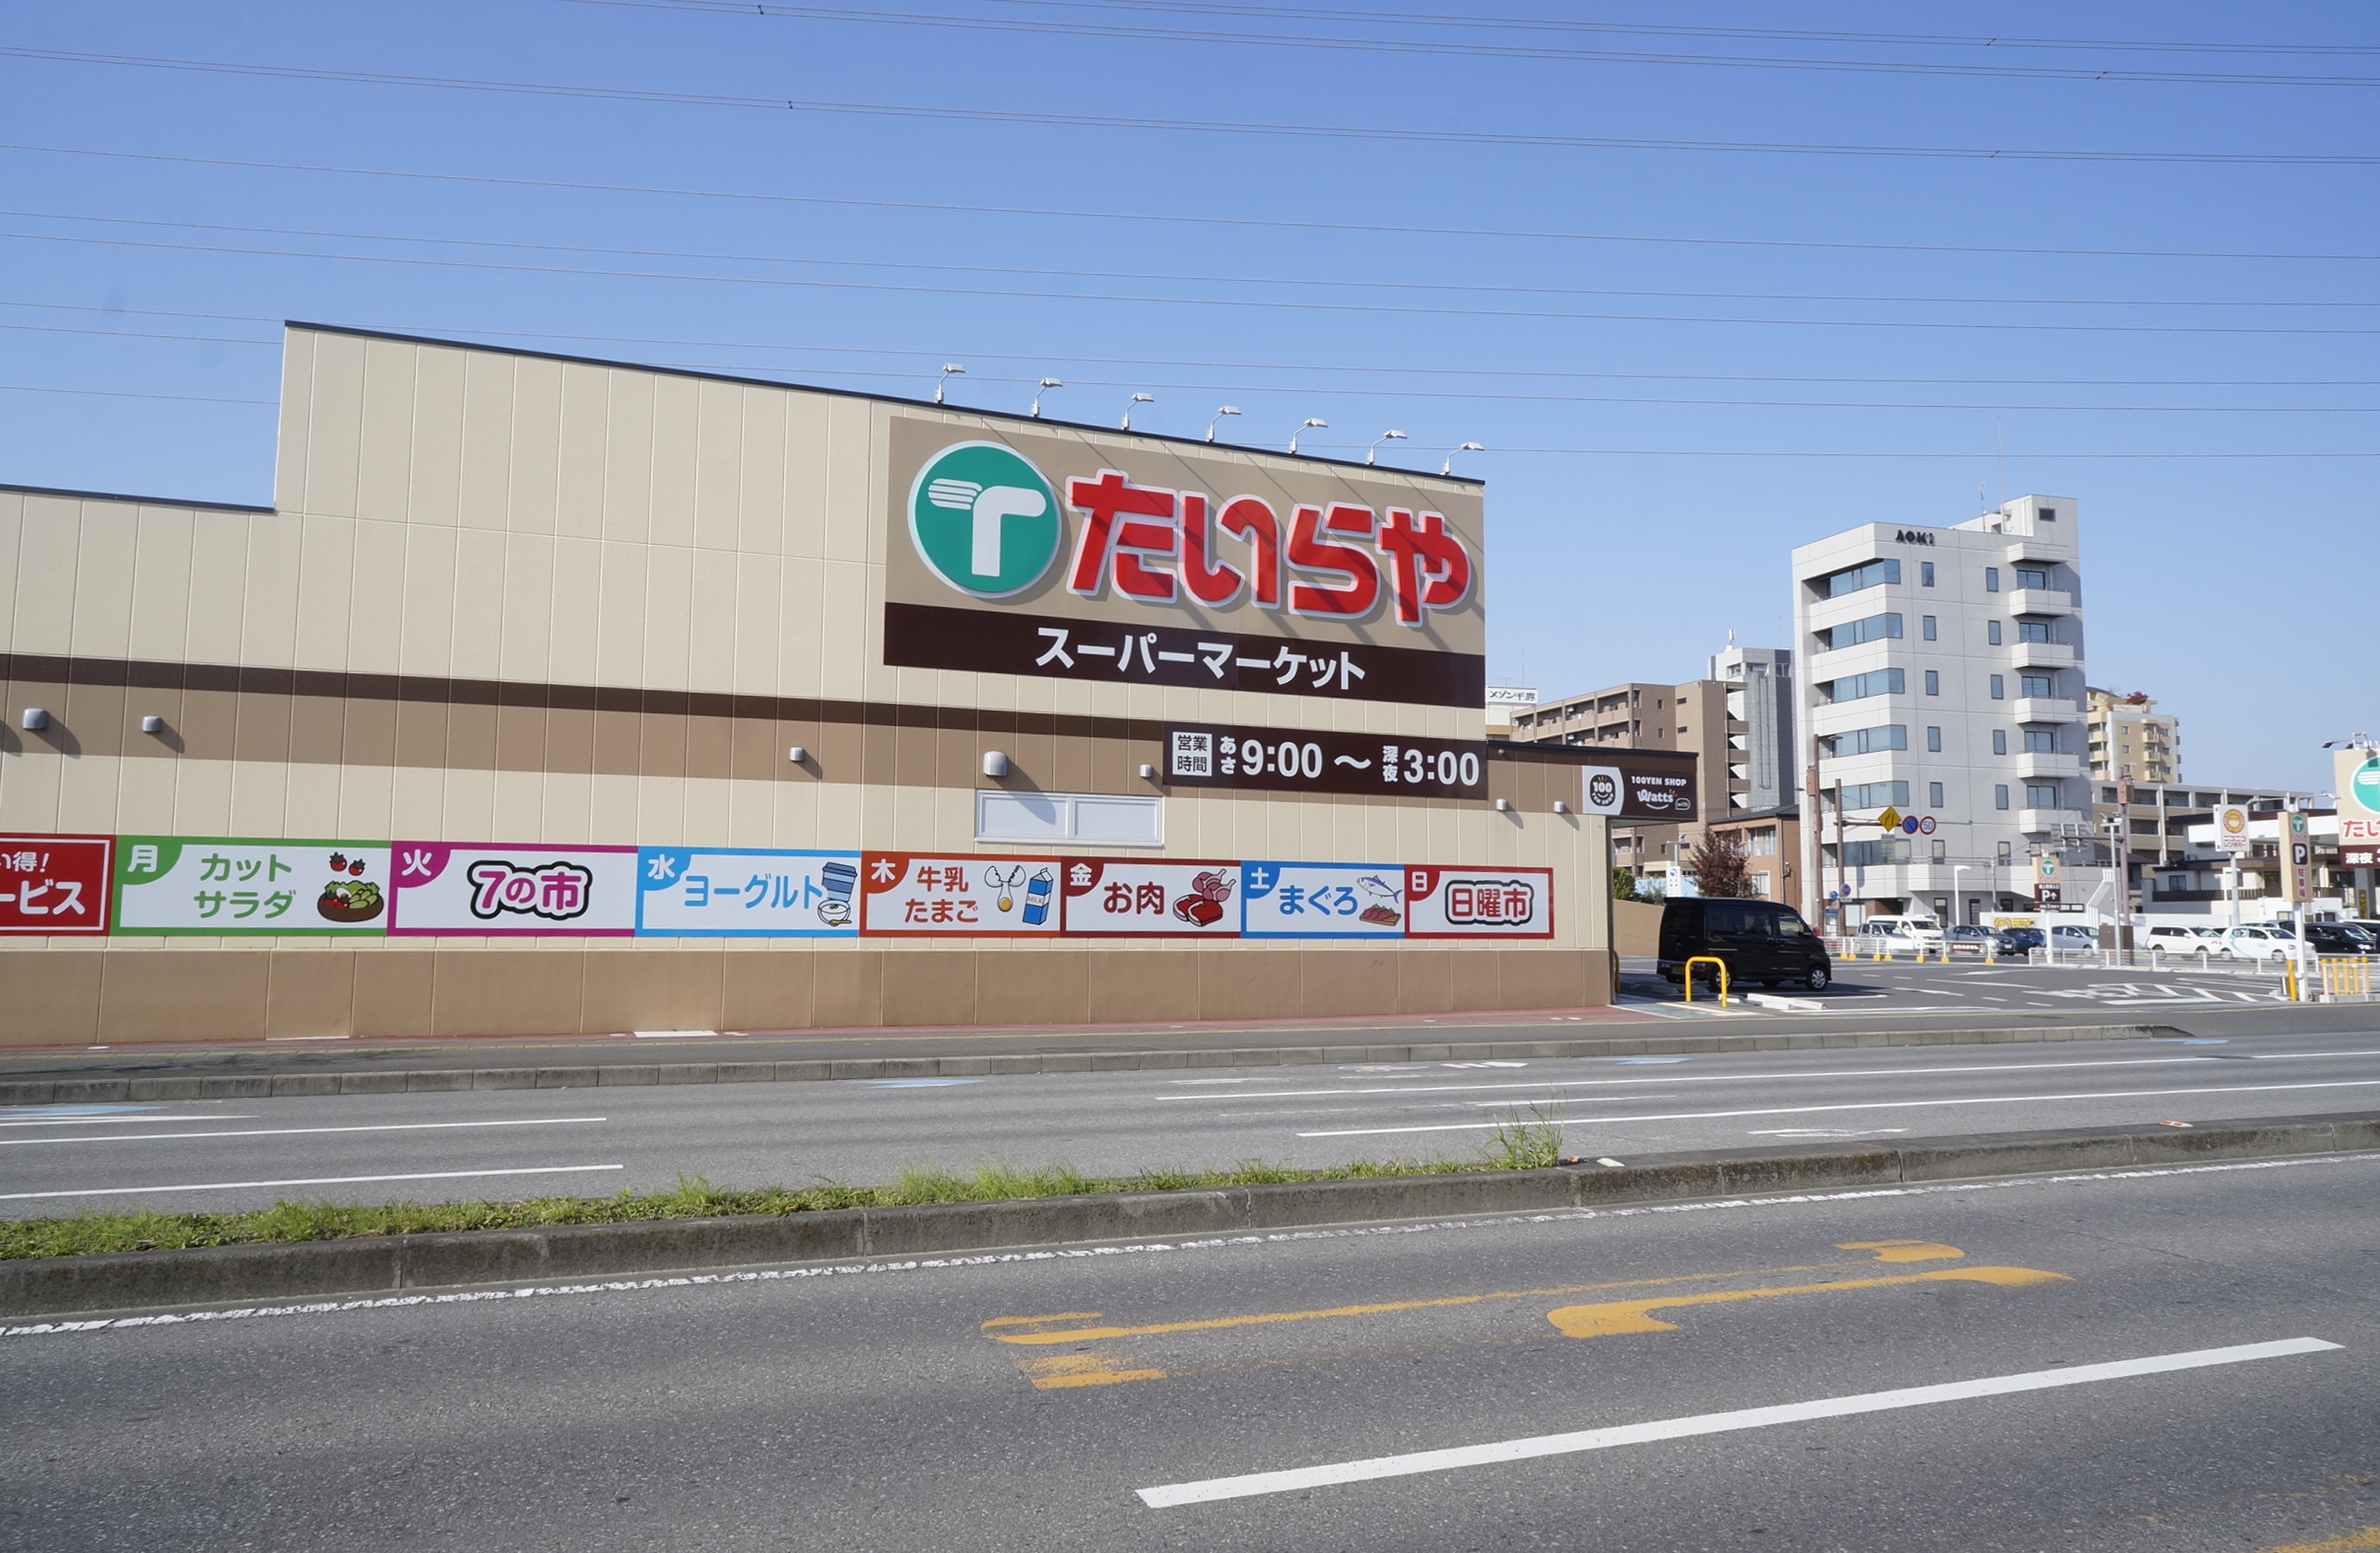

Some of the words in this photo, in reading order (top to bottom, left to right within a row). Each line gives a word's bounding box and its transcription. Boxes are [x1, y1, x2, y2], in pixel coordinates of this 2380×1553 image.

[1067, 468, 1474, 627] たいらや
[1894, 529, 1934, 545] AOKI
[1034, 626, 1366, 691] スーパーマーケット
[1176, 734, 1209, 753] 営業
[1220, 736, 1237, 776] あさ
[1240, 738, 1324, 778] 9:00
[1176, 755, 1209, 774] 時間
[1382, 745, 1400, 783] 深夜
[1403, 748, 1481, 786] 3:00
[1592, 781, 1614, 793] 100
[1630, 776, 1663, 785] 100YEN
[1664, 776, 1687, 787] SHOP
[1636, 788, 1675, 803] Watts
[1923, 820, 1934, 831] 50
[127, 844, 159, 873] 月
[199, 852, 294, 883] カット
[401, 848, 432, 877] 火
[647, 853, 676, 880] 水
[2294, 844, 2306, 863] P
[871, 858, 896, 884] 木
[916, 864, 969, 893] 牛乳
[1068, 862, 1093, 886] 金
[1249, 866, 1272, 890] 土
[1412, 871, 1428, 892] 日
[193, 889, 297, 919] サラダ
[477, 869, 579, 912] 7の市
[683, 873, 824, 910] ヨーグルト
[1102, 881, 1166, 915] お肉
[1278, 884, 1359, 916] まぐろ
[1450, 881, 1530, 919] 日曜市
[2041, 890, 2051, 902] P
[904, 898, 979, 924] たまご
